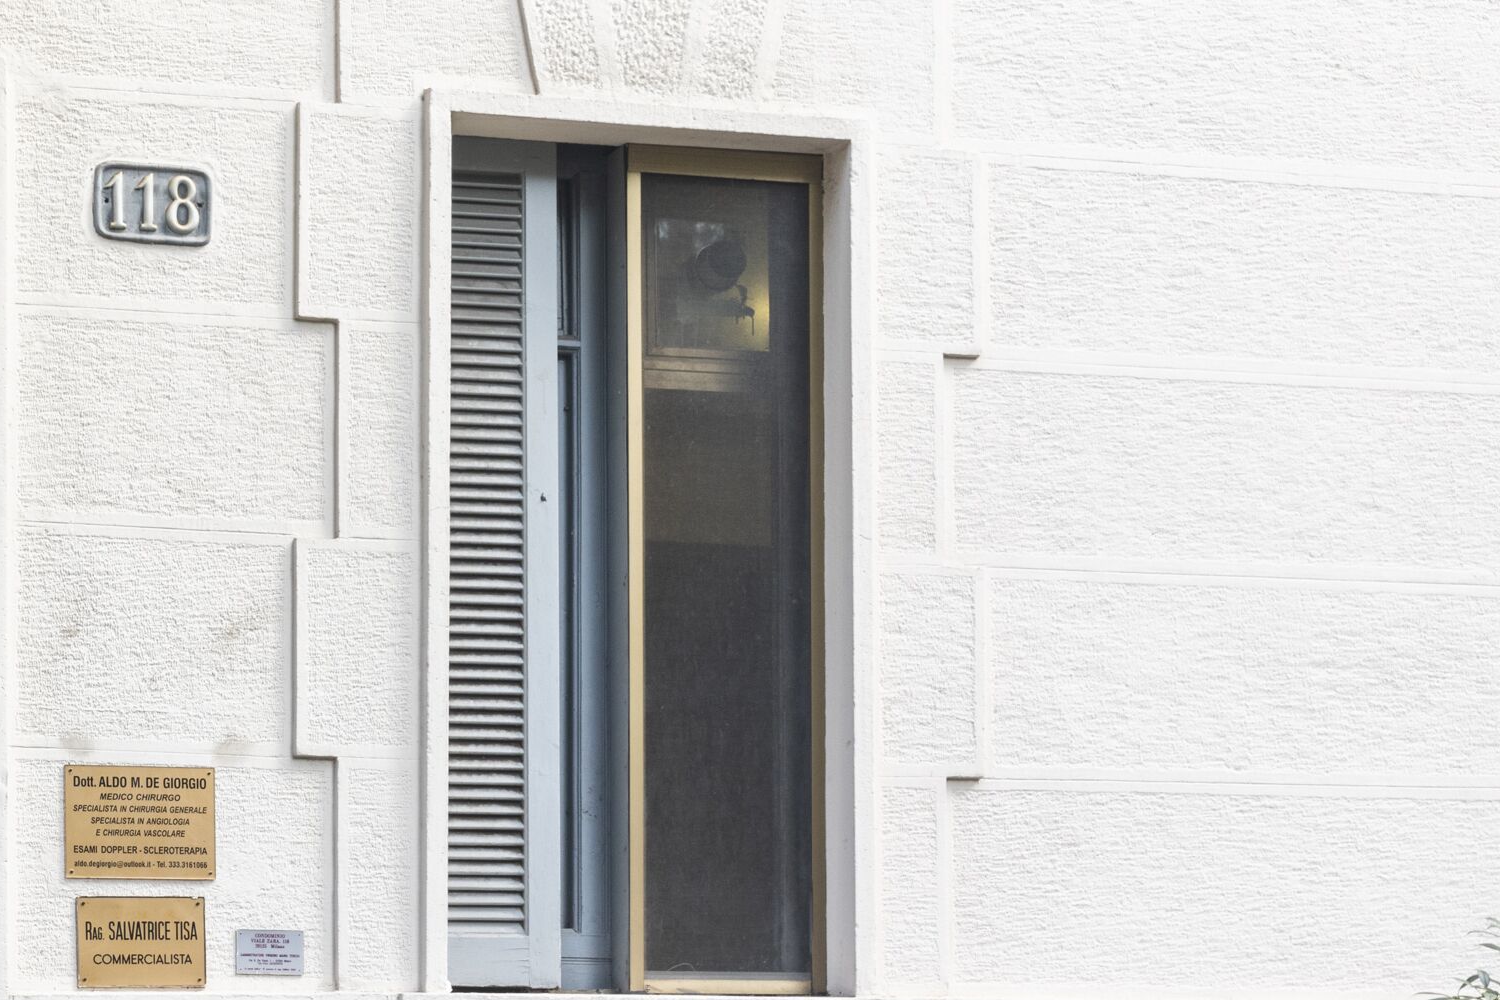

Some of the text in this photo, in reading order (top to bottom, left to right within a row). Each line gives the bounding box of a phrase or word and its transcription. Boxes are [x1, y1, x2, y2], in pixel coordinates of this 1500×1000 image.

[103, 171, 200, 235] 118
[73, 775, 207, 790] Dott. ALDO M. DE GIORGIO
[99, 792, 181, 802] MEDICO CHIRURGO
[72, 804, 118, 812] SPECIALISTA
[128, 805, 167, 813] CHIRURGIA
[169, 806, 208, 814] GENERALE
[90, 816, 190, 826] SPECIALISTA IN ANGIOLOGIA
[95, 828, 186, 838] E CHIRURGIA VASCOLARE
[73, 844, 98, 854] ESAMI
[100, 845, 138, 854] DOPPLER
[143, 846, 208, 855] SCLEROTERAPIA
[156, 860, 167, 868] Tel.
[108, 921, 171, 941] SALVATRICE
[173, 921, 198, 941] TISA
[92, 953, 193, 965] COMMERCIALISTA
